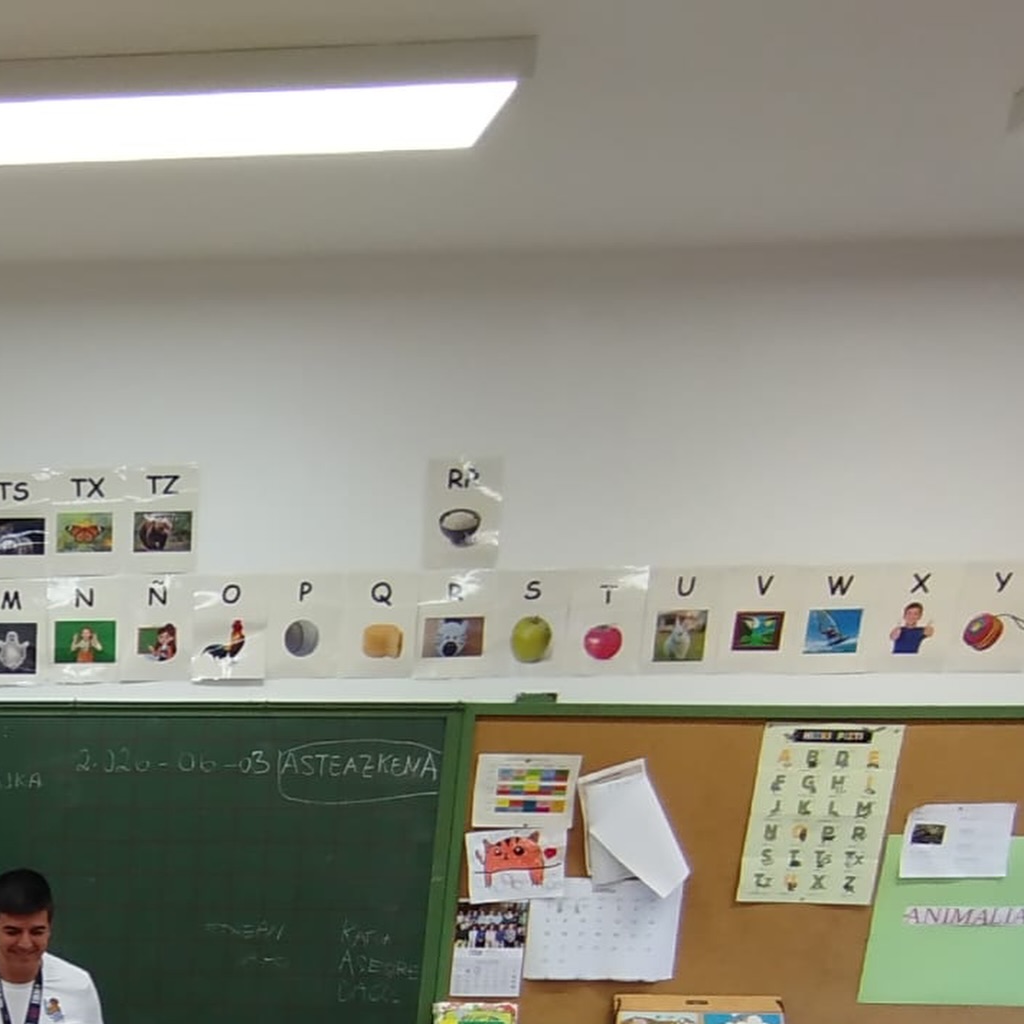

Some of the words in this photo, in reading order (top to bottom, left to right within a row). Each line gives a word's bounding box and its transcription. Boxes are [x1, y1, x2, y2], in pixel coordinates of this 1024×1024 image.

[70, 477, 105, 498] TX
[146, 474, 180, 495] TZ
[148, 579, 167, 606] Ñ
[298, 581, 313, 602] P
[523, 580, 543, 601] S
[677, 576, 696, 598] U
[757, 575, 775, 597] V
[827, 575, 855, 597] W
[910, 572, 932, 595] X
[995, 571, 1014, 593] Y
[1, 590, 22, 610] M
[74, 588, 94, 608] N
[222, 584, 242, 604] O
[371, 581, 393, 606] Q
[599, 583, 619, 604] T
[280, 751, 438, 780] ASTEAZKENA
[851, 826, 866, 841] R
